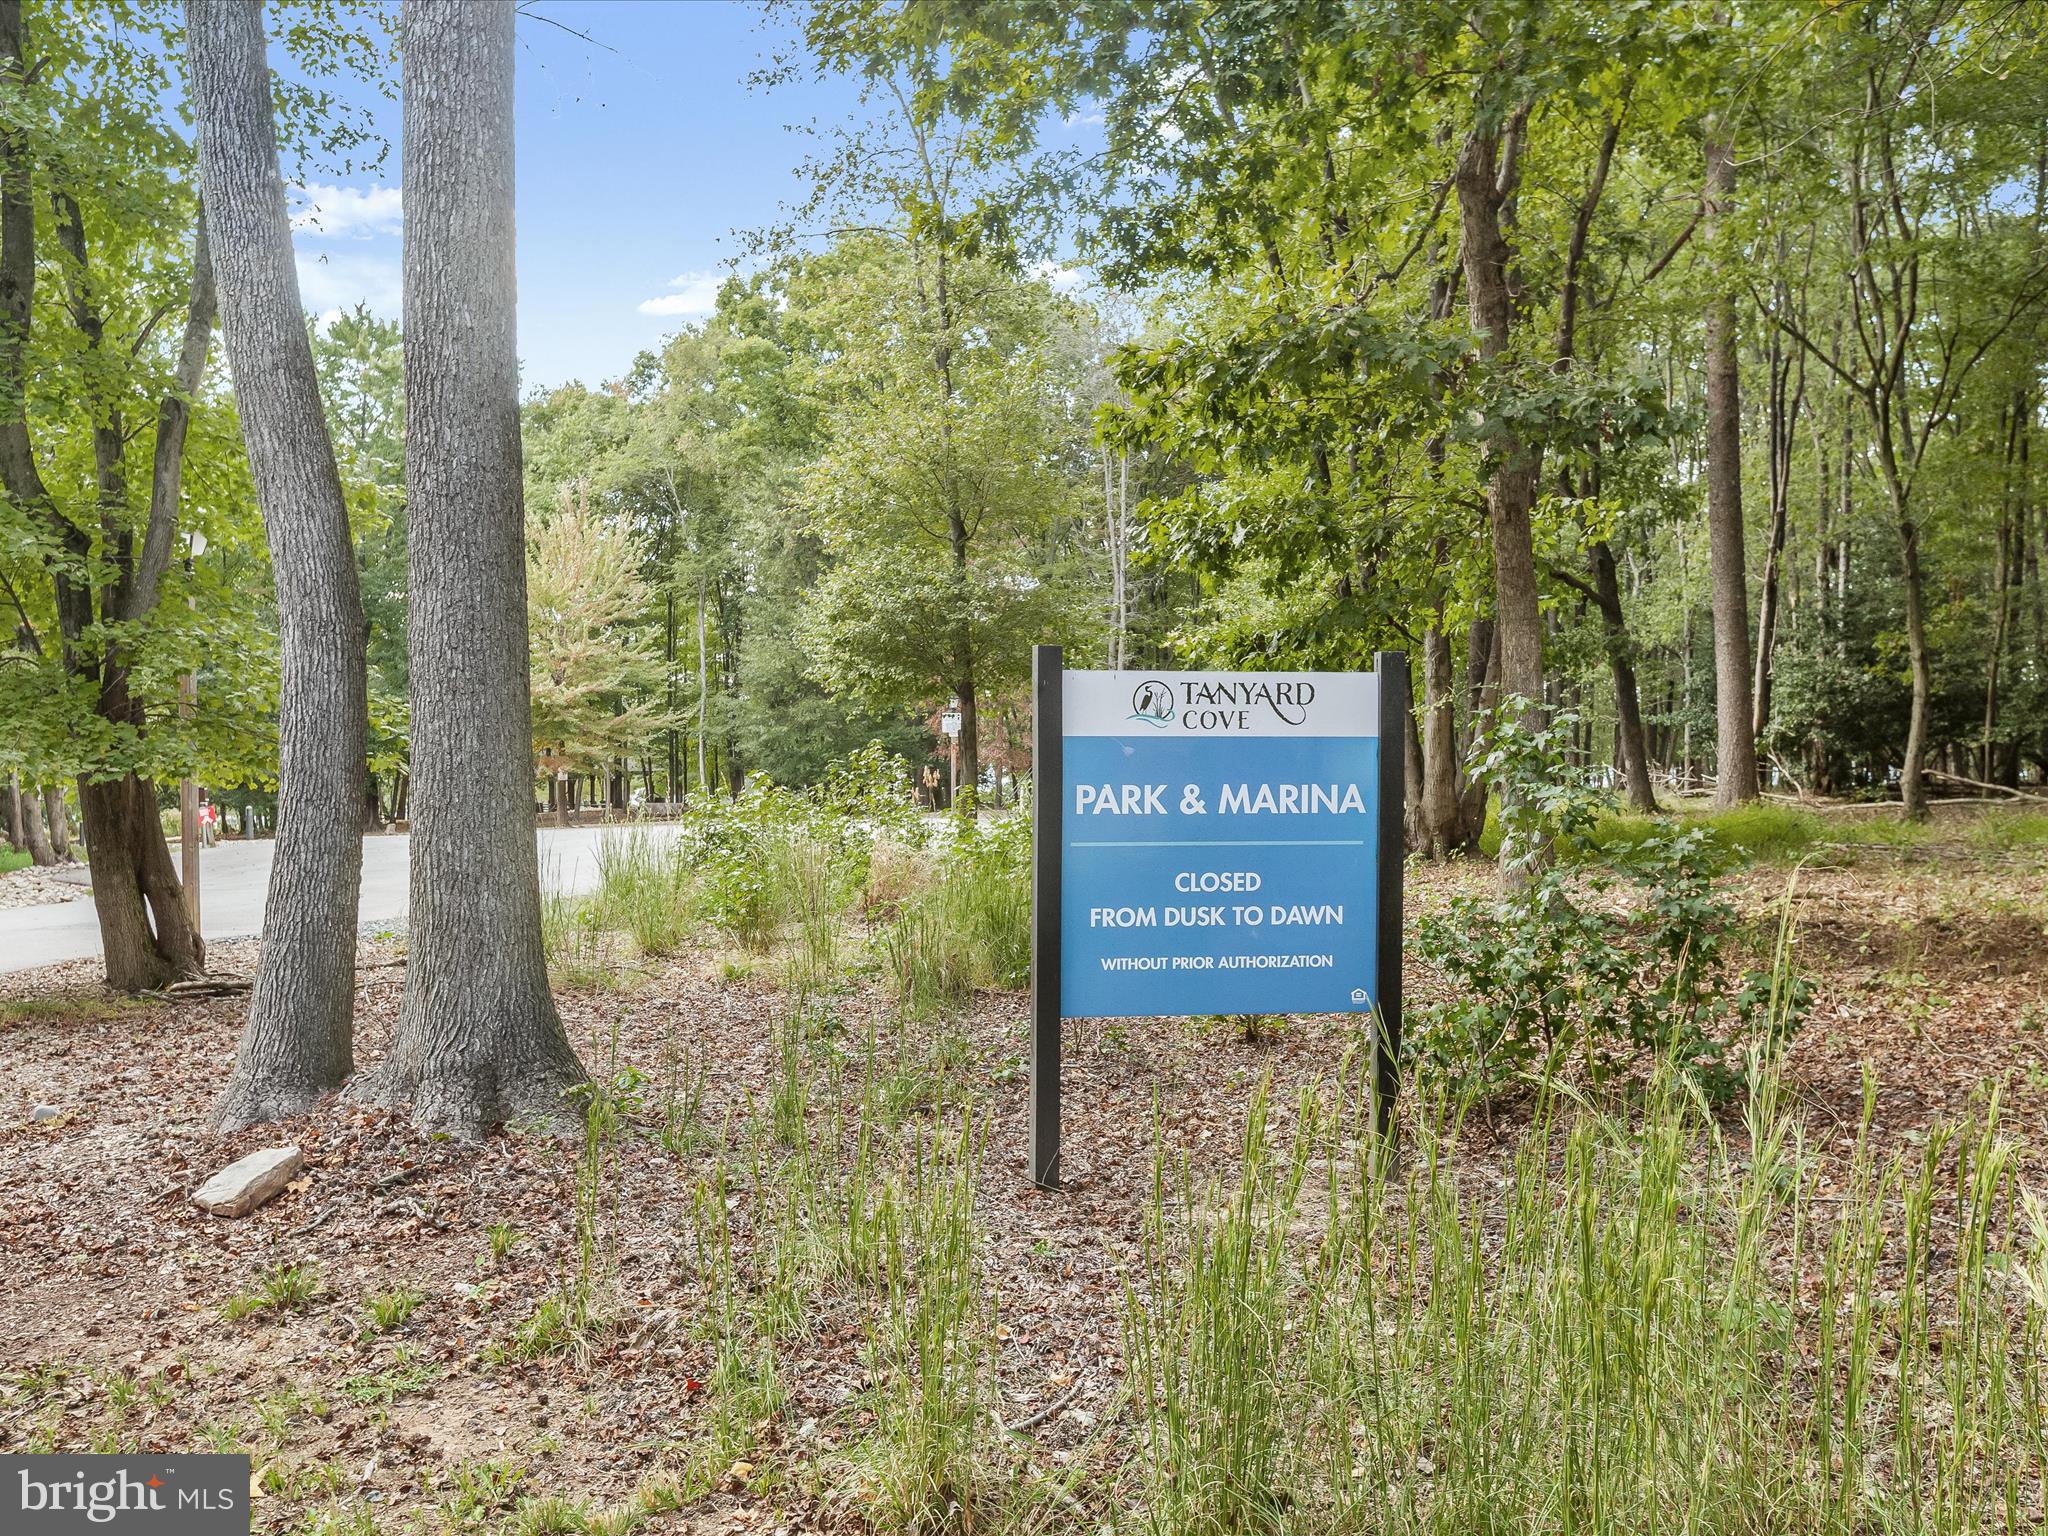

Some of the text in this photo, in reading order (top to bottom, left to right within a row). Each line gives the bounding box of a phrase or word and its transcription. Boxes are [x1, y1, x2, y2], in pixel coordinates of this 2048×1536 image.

[1180, 681, 1316, 725] TANYARD
[1182, 710, 1250, 730] COVE
[1075, 783, 1367, 815] PARK & MARINA
[1174, 871, 1262, 893] CLOSED
[1090, 905, 1344, 928] FROM DUSK TO DAWN
[1101, 955, 1333, 971] WITHOUT PRIOR AUTHORIZATION
